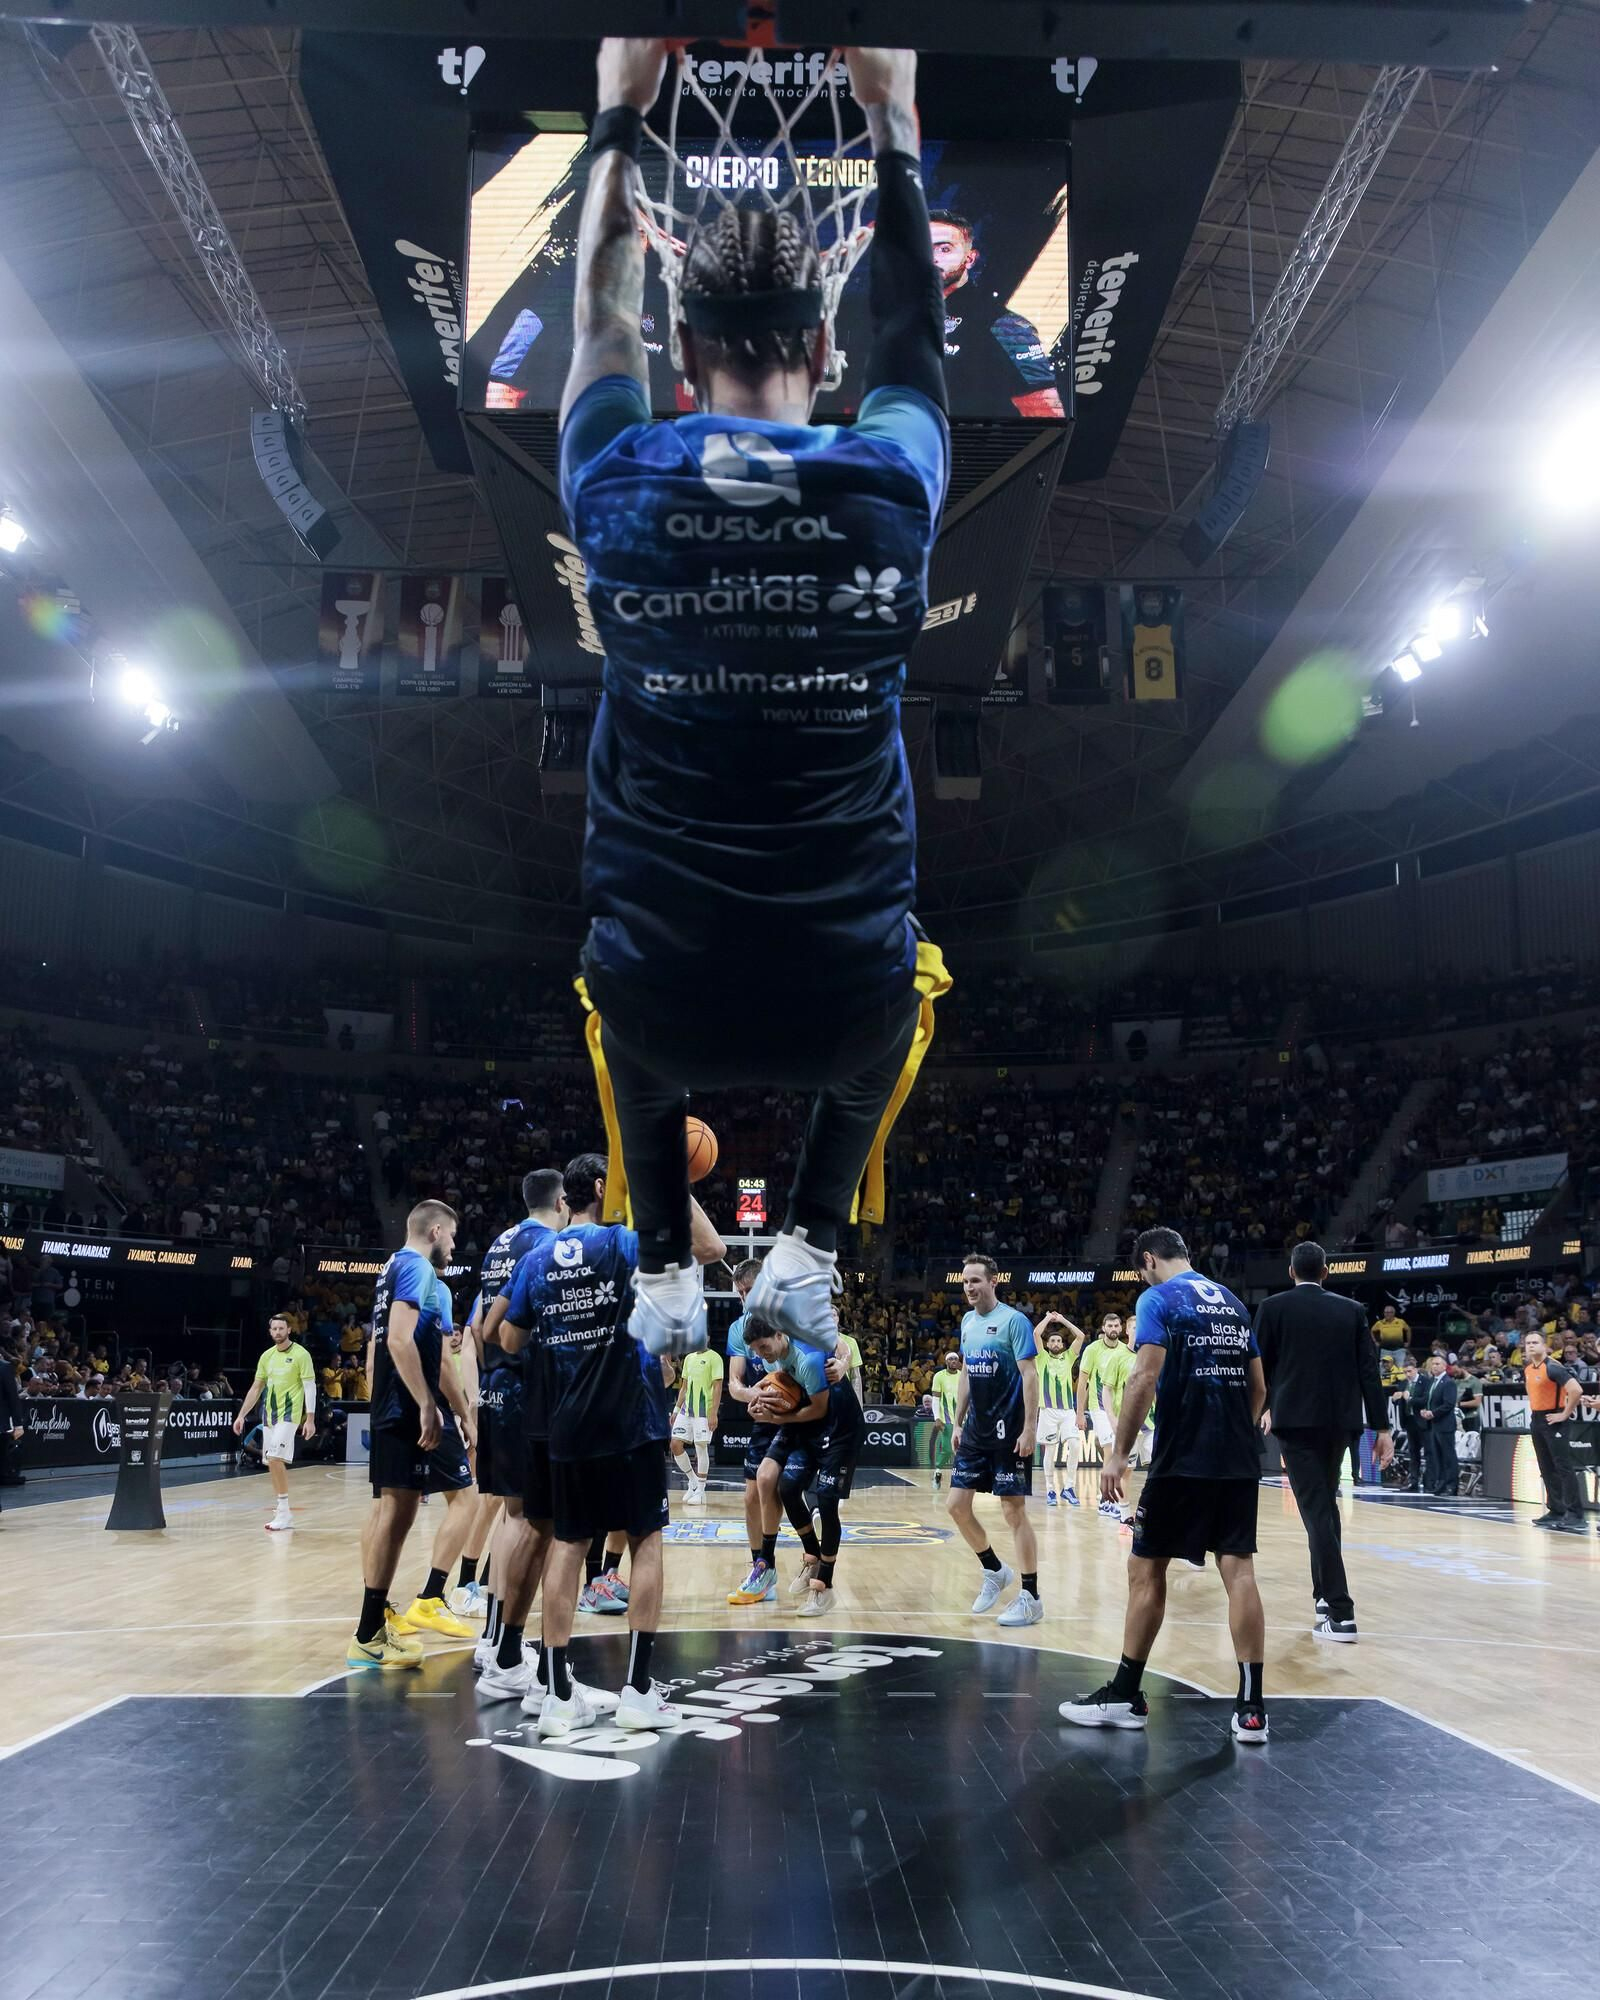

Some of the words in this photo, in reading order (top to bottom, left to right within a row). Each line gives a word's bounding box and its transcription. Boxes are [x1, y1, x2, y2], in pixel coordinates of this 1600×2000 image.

[437, 45, 486, 95] t!
[1051, 56, 1098, 104] t!
[685, 155, 779, 190] CUERPO
[665, 512, 848, 541] austral
[613, 585, 820, 622] Canarias
[786, 623, 819, 640] VIDA
[1145, 656, 1163, 681] 8
[643, 664, 870, 696] azulmarino
[763, 706, 808, 722] new
[814, 703, 869, 722] travel
[1473, 1165, 1508, 1182] DXT
[738, 1179, 765, 1188] 04:43
[739, 1194, 763, 1211] 24
[41, 1240, 70, 1257] ¡VAMOS,
[71, 1243, 111, 1259] CANARIAS!
[127, 1248, 157, 1264] ¡VAMOS,
[157, 1250, 198, 1265] CANARIAS!
[317, 1260, 347, 1274] ¡VAMOS,
[1328, 1260, 1367, 1274] CANARIAS!
[1383, 1257, 1411, 1272] ¡VAMOS,
[1412, 1253, 1450, 1269] CANARIAS!
[546, 1265, 596, 1282] austral
[1028, 1272, 1057, 1284] ¡VAMOS,
[1057, 1271, 1095, 1283] CANARIAS!
[83, 1278, 115, 1291] TEN
[561, 1286, 593, 1301] Islas
[542, 1298, 594, 1316] anarias
[1196, 1303, 1240, 1317] austral
[1210, 1321, 1237, 1335] Islas
[1187, 1334, 1240, 1347] Canarias
[966, 1349, 998, 1359] LAGUNA
[996, 1419, 1006, 1440] 9
[863, 1431, 907, 1446] esa
